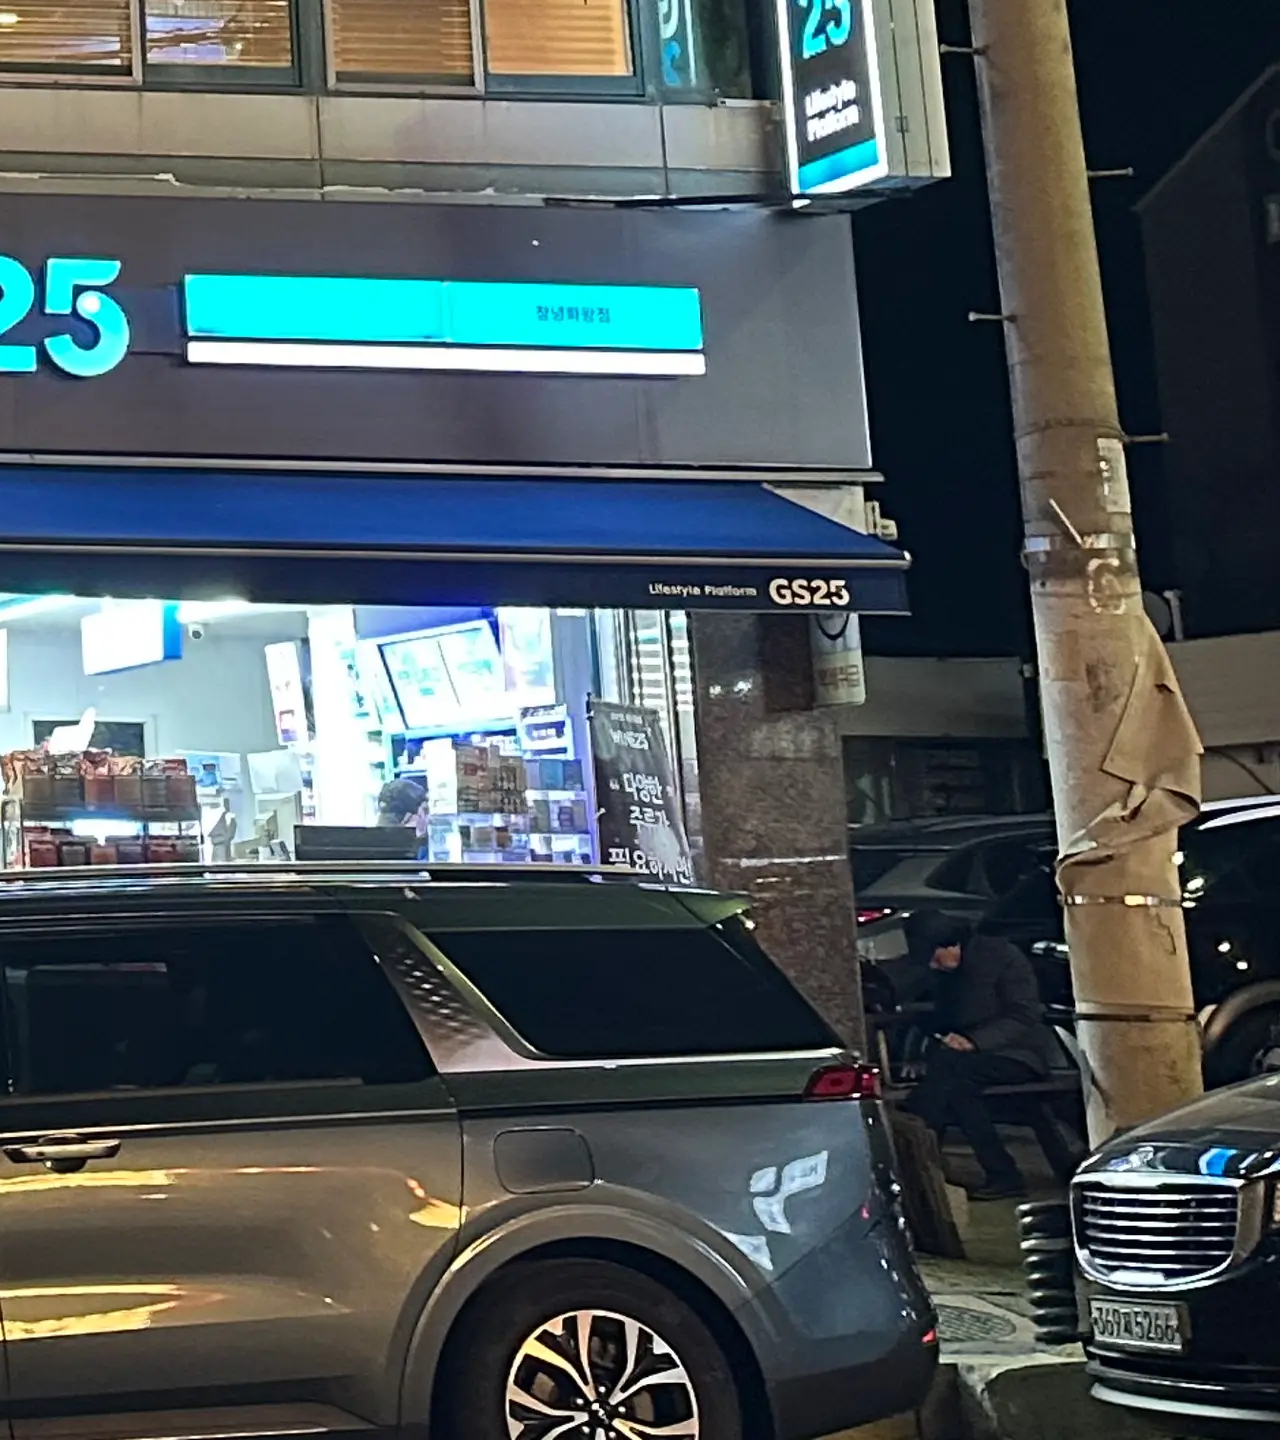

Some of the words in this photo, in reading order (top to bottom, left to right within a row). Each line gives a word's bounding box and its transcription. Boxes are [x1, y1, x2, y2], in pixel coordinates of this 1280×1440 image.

[648, 582, 701, 598] Lifestyle
[703, 584, 758, 597] Platform
[768, 577, 851, 606] GS25
